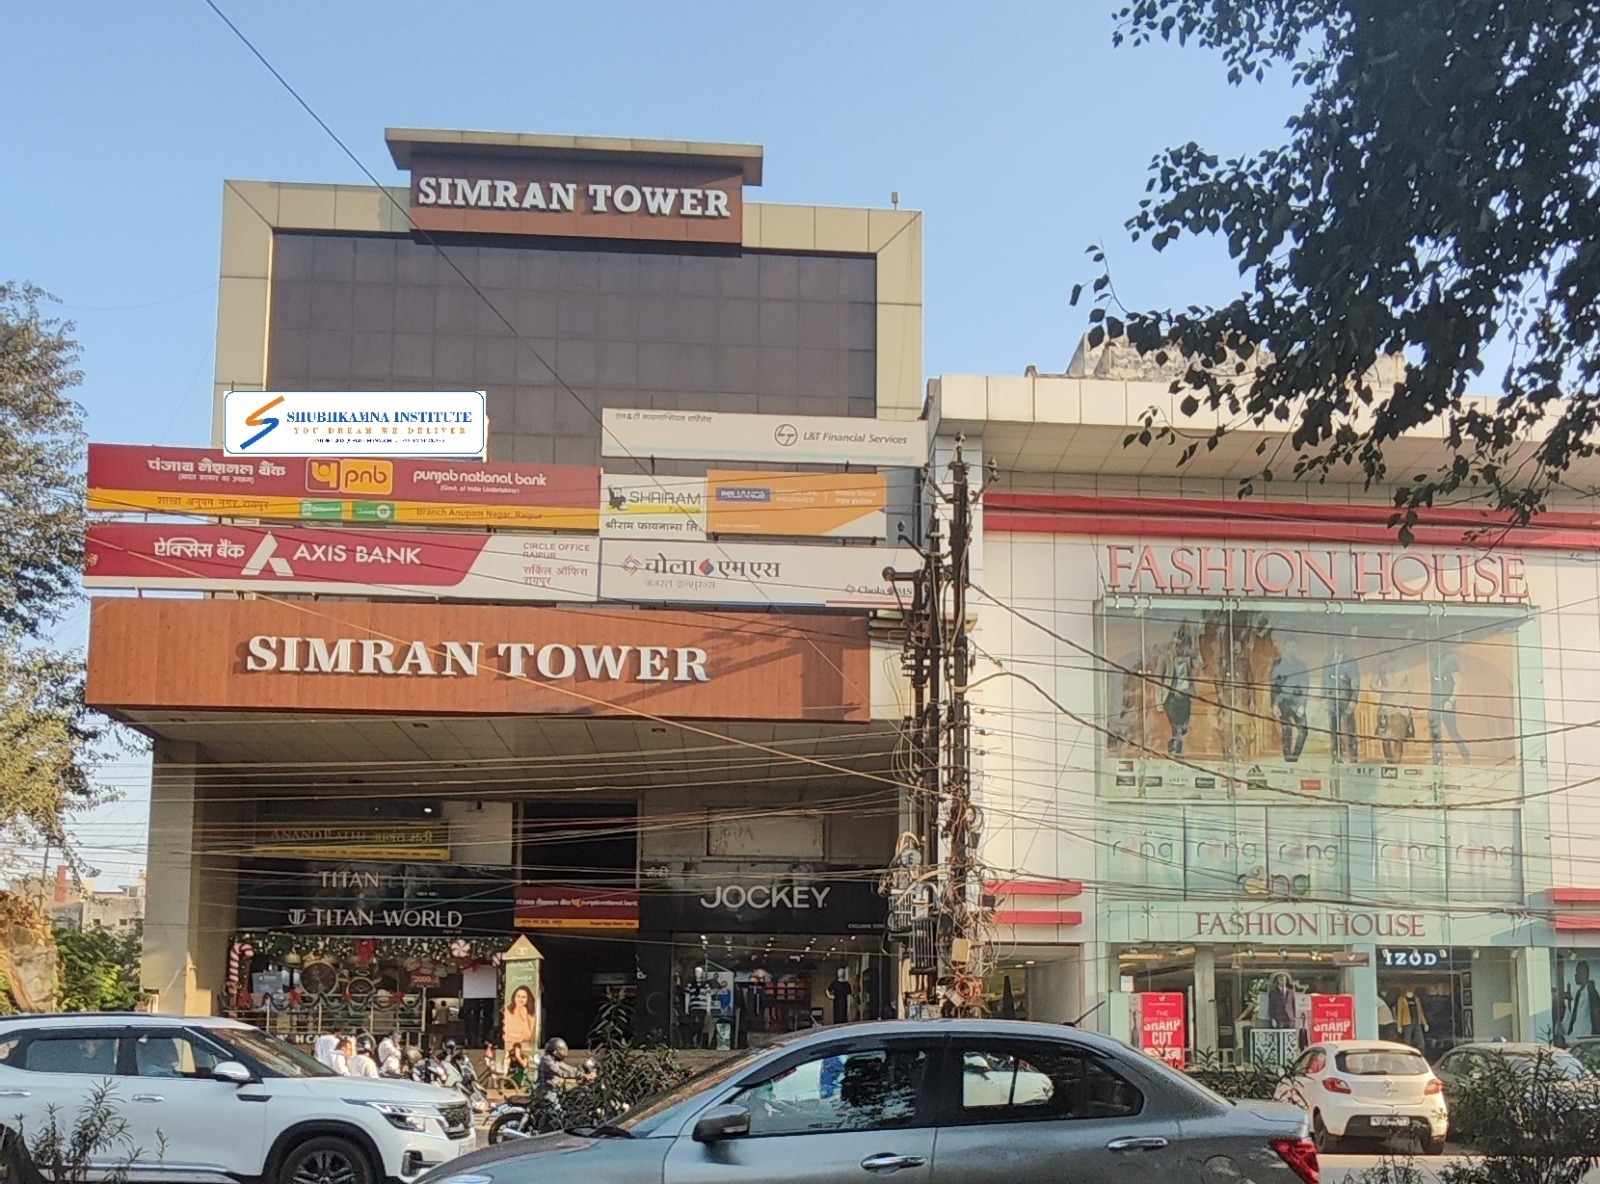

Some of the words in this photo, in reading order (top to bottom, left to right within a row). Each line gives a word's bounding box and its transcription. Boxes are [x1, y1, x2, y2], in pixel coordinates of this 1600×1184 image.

[418, 176, 577, 212] SIMRAN
[588, 183, 731, 218] TOWER
[803, 432, 821, 441] L&T
[822, 432, 866, 443] Financial
[868, 435, 908, 444] Services
[147, 457, 194, 472] पंजाब
[258, 460, 286, 477] बैंक
[344, 465, 388, 488] pnb
[413, 469, 459, 485] punjab
[459, 470, 514, 485] national
[514, 472, 547, 487] bank
[157, 495, 181, 506] शाखा
[186, 497, 214, 509] अनुपम
[218, 498, 239, 508] नगर
[629, 490, 701, 505] SHRIRAM
[416, 507, 447, 516] Branch
[448, 508, 484, 518] Anupam
[514, 511, 543, 520] Raipur
[604, 518, 634, 530] श्रीराम
[153, 536, 213, 558] ऐक्सिस
[216, 538, 245, 559] बैंक
[292, 543, 347, 563] AXIS
[355, 545, 422, 565] BANK
[523, 542, 556, 551] CIRCLE
[558, 543, 590, 552] OFFICE
[522, 551, 557, 559] RAIPUR
[556, 565, 588, 577] ऑफिस
[645, 552, 697, 576] चोला
[1106, 544, 1339, 596] FASHION
[1352, 550, 1530, 599] HOUSE
[857, 585, 886, 594] Chola
[246, 635, 483, 677] SIMRAN
[498, 642, 711, 683] TOWER
[1382, 769, 1397, 778] Lee
[319, 871, 379, 888] TITAN
[700, 885, 831, 909] JOCKEY
[312, 909, 374, 927] TITAN
[382, 910, 463, 928] WORLD
[1195, 912, 1319, 936] FASHION
[1329, 913, 1426, 937] HOUSE
[1384, 952, 1438, 966] IZOD
[1156, 1009, 1169, 1017] THE
[1143, 1019, 1181, 1031] SHARP
[1313, 1020, 1351, 1032] SHARP
[1151, 1031, 1174, 1046] CUT
[1321, 1032, 1343, 1043] CUT
